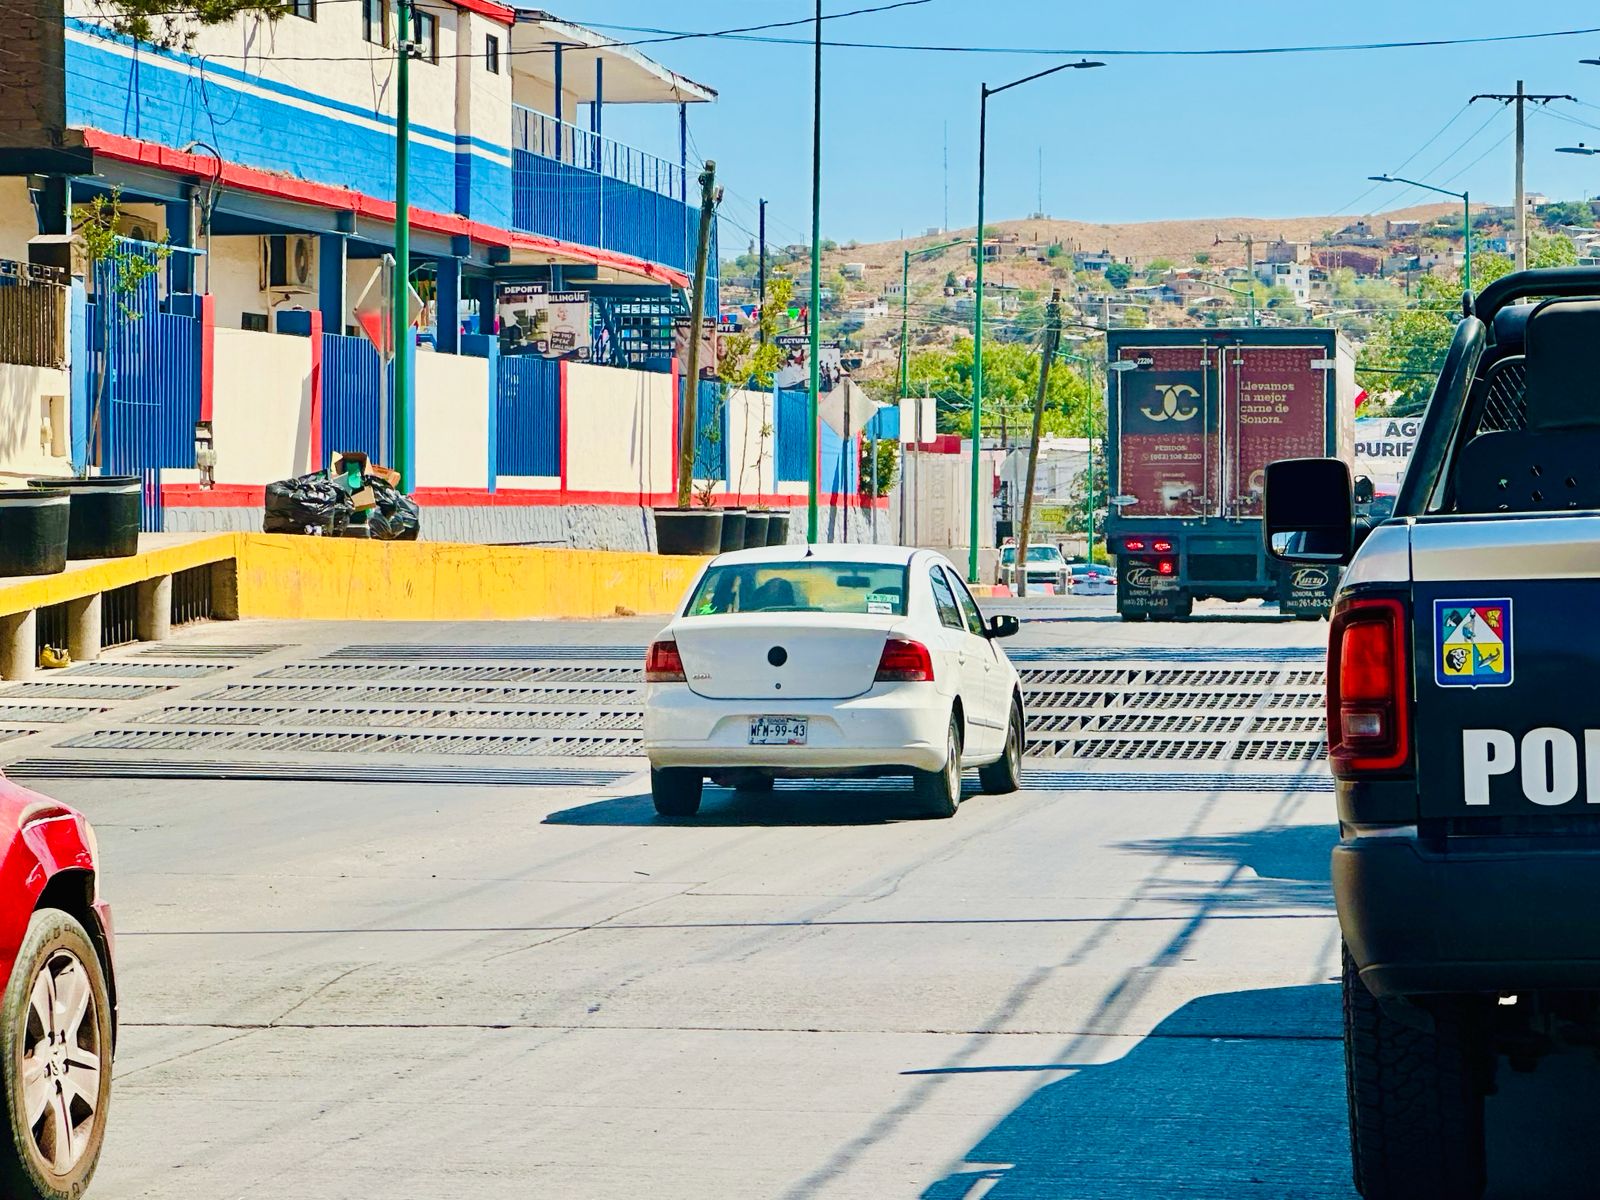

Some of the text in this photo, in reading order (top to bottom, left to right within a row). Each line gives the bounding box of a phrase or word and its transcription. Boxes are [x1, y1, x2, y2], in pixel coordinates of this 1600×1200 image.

[504, 286, 543, 294] DEPORTE
[717, 323, 736, 332] RTE
[1241, 381, 1295, 391] Llevamos
[1241, 392, 1287, 404] la mejor
[1241, 403, 1289, 413] carne de
[1241, 414, 1283, 424] Sonora.
[1385, 421, 1420, 438] AG
